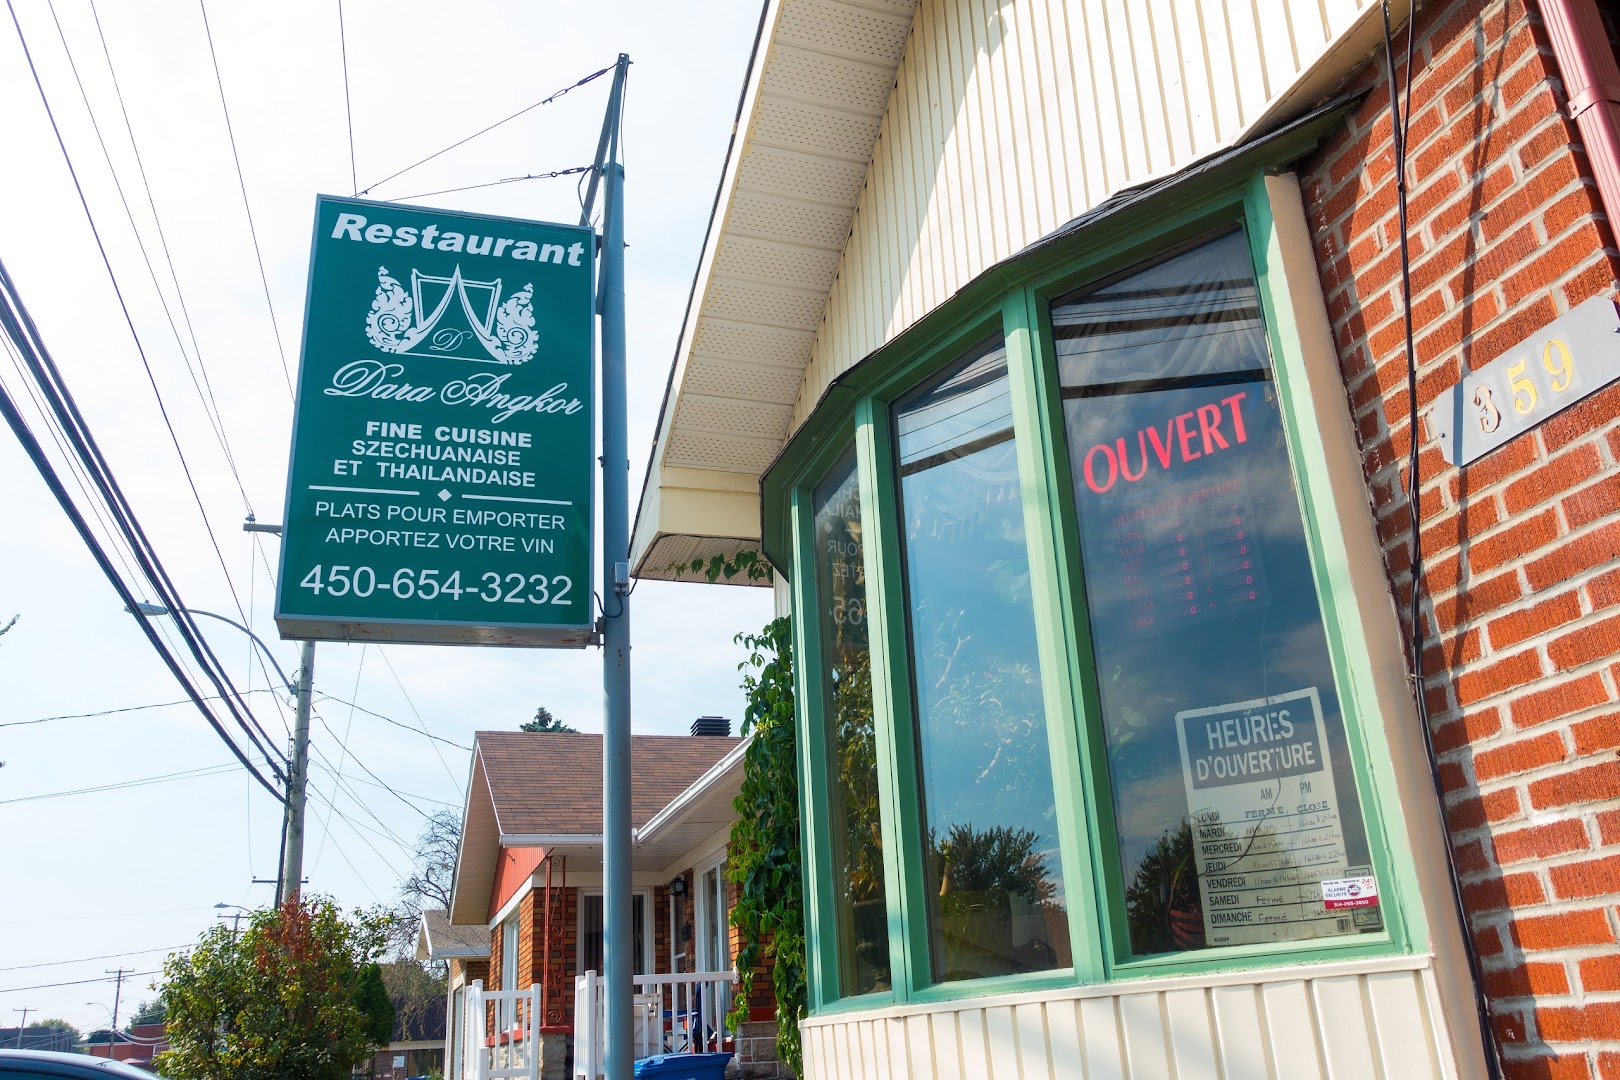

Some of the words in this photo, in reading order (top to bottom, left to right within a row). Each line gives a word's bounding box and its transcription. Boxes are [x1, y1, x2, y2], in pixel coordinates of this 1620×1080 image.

[331, 212, 585, 267] Restaurant
[323, 359, 437, 403] Dara
[440, 372, 584, 424] Angkor
[1473, 338, 1573, 433] 359
[366, 421, 422, 440] FINE
[434, 426, 532, 448] CUISINE
[1083, 391, 1247, 494] OUVERT
[351, 440, 521, 466] SZECHUANAISE
[333, 460, 362, 475] ET
[376, 462, 536, 487] THAILANDAISE
[315, 502, 381, 519] PLATS
[387, 506, 447, 523] POUR
[453, 510, 566, 530] EMPORTER
[325, 528, 440, 548] APPORTEZ
[446, 534, 516, 552] VOTRE
[522, 538, 554, 554] VIN
[300, 564, 573, 606] 450-654-3232
[1206, 710, 1294, 750] HEURES
[1196, 742, 1316, 782] D'OUVERTURE
[1260, 787, 1273, 801] AM
[1299, 781, 1312, 795] PM
[1197, 811, 1220, 823] LUNDI
[1297, 800, 1328, 813] CLOSE
[1199, 827, 1226, 839] MARDI
[1201, 842, 1242, 855] MERCREDI
[1204, 861, 1227, 873] JEUDI
[1206, 877, 1247, 890] VENDREDI
[1209, 894, 1240, 907] SAMEDI
[1211, 911, 1253, 924] DIMANCHE
